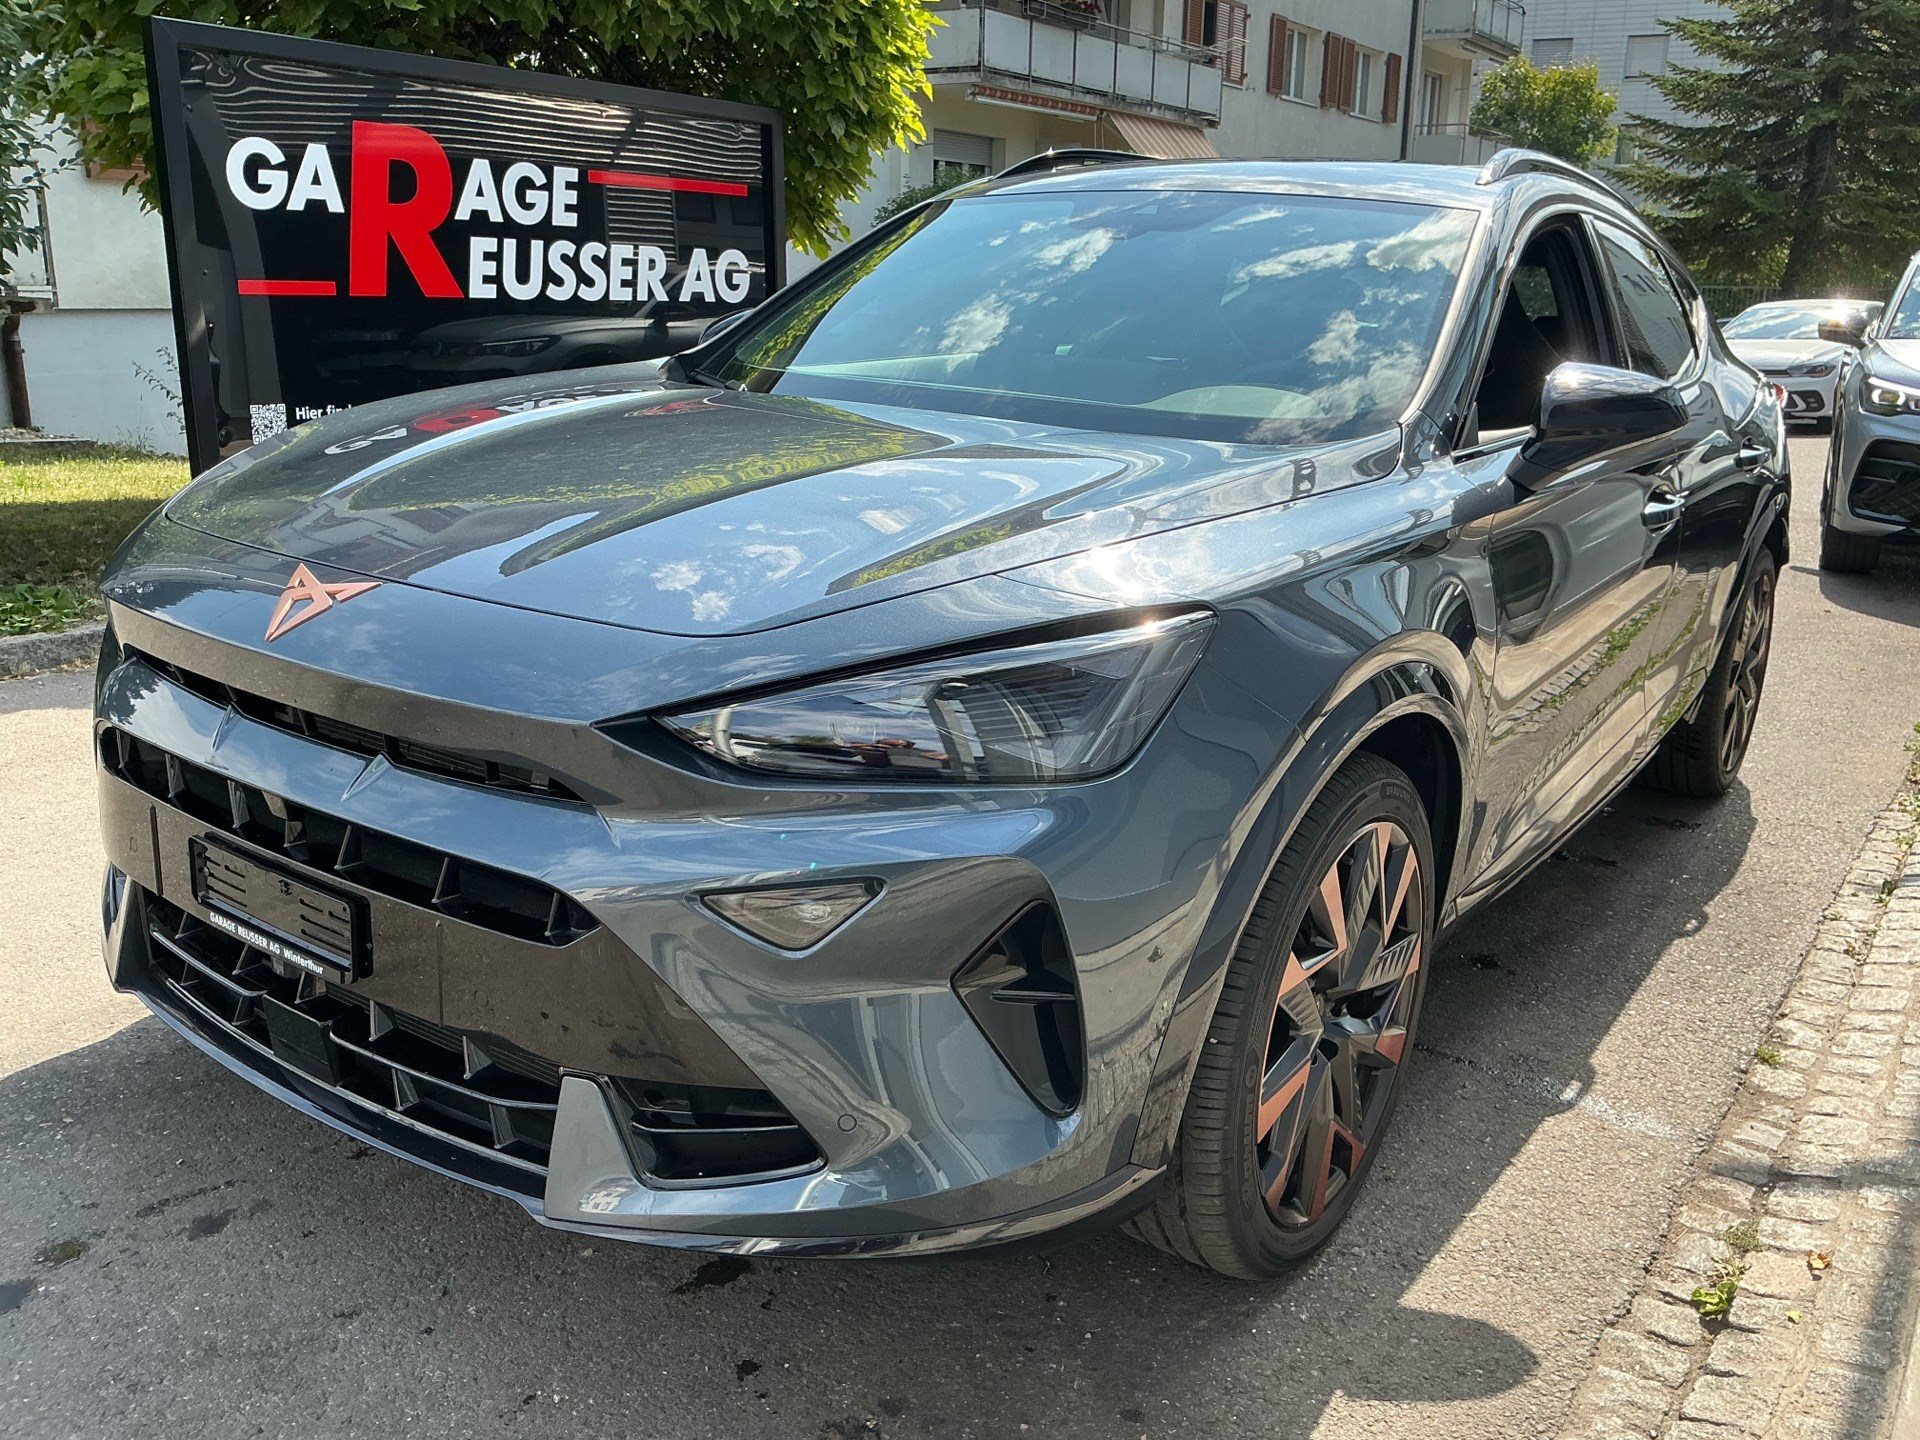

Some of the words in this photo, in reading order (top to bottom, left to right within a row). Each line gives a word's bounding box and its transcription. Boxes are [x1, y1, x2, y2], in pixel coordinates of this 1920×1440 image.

[225, 120, 579, 298] GARAGE
[680, 248, 750, 303] AG
[295, 406, 323, 420] Hier
[209, 912, 236, 933] GARAGE
[237, 926, 268, 948] REUSSER
[269, 941, 280, 955] AG
[283, 947, 324, 975] Winterthur
